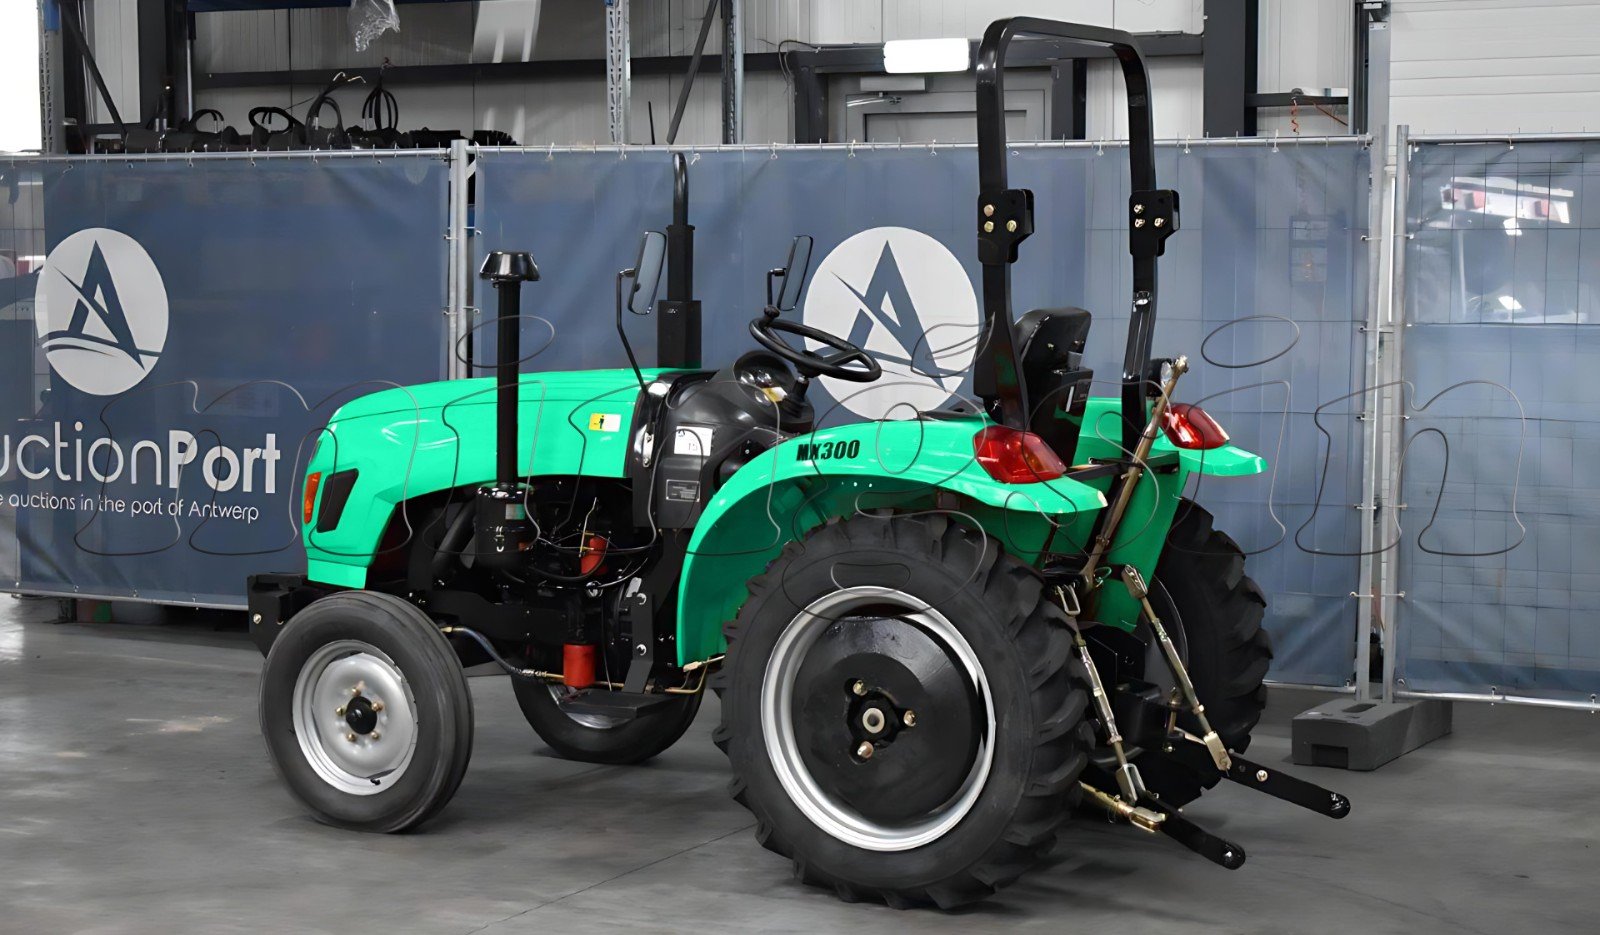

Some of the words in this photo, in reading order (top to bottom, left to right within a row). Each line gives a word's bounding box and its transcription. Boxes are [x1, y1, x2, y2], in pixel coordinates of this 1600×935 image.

[796, 440, 860, 461] MX300
[9, 492, 76, 511] auctions
[80, 494, 94, 511] in
[98, 495, 125, 512] the
[131, 498, 163, 518] port
[168, 499, 184, 516] of
[188, 500, 259, 524] Antwerp
